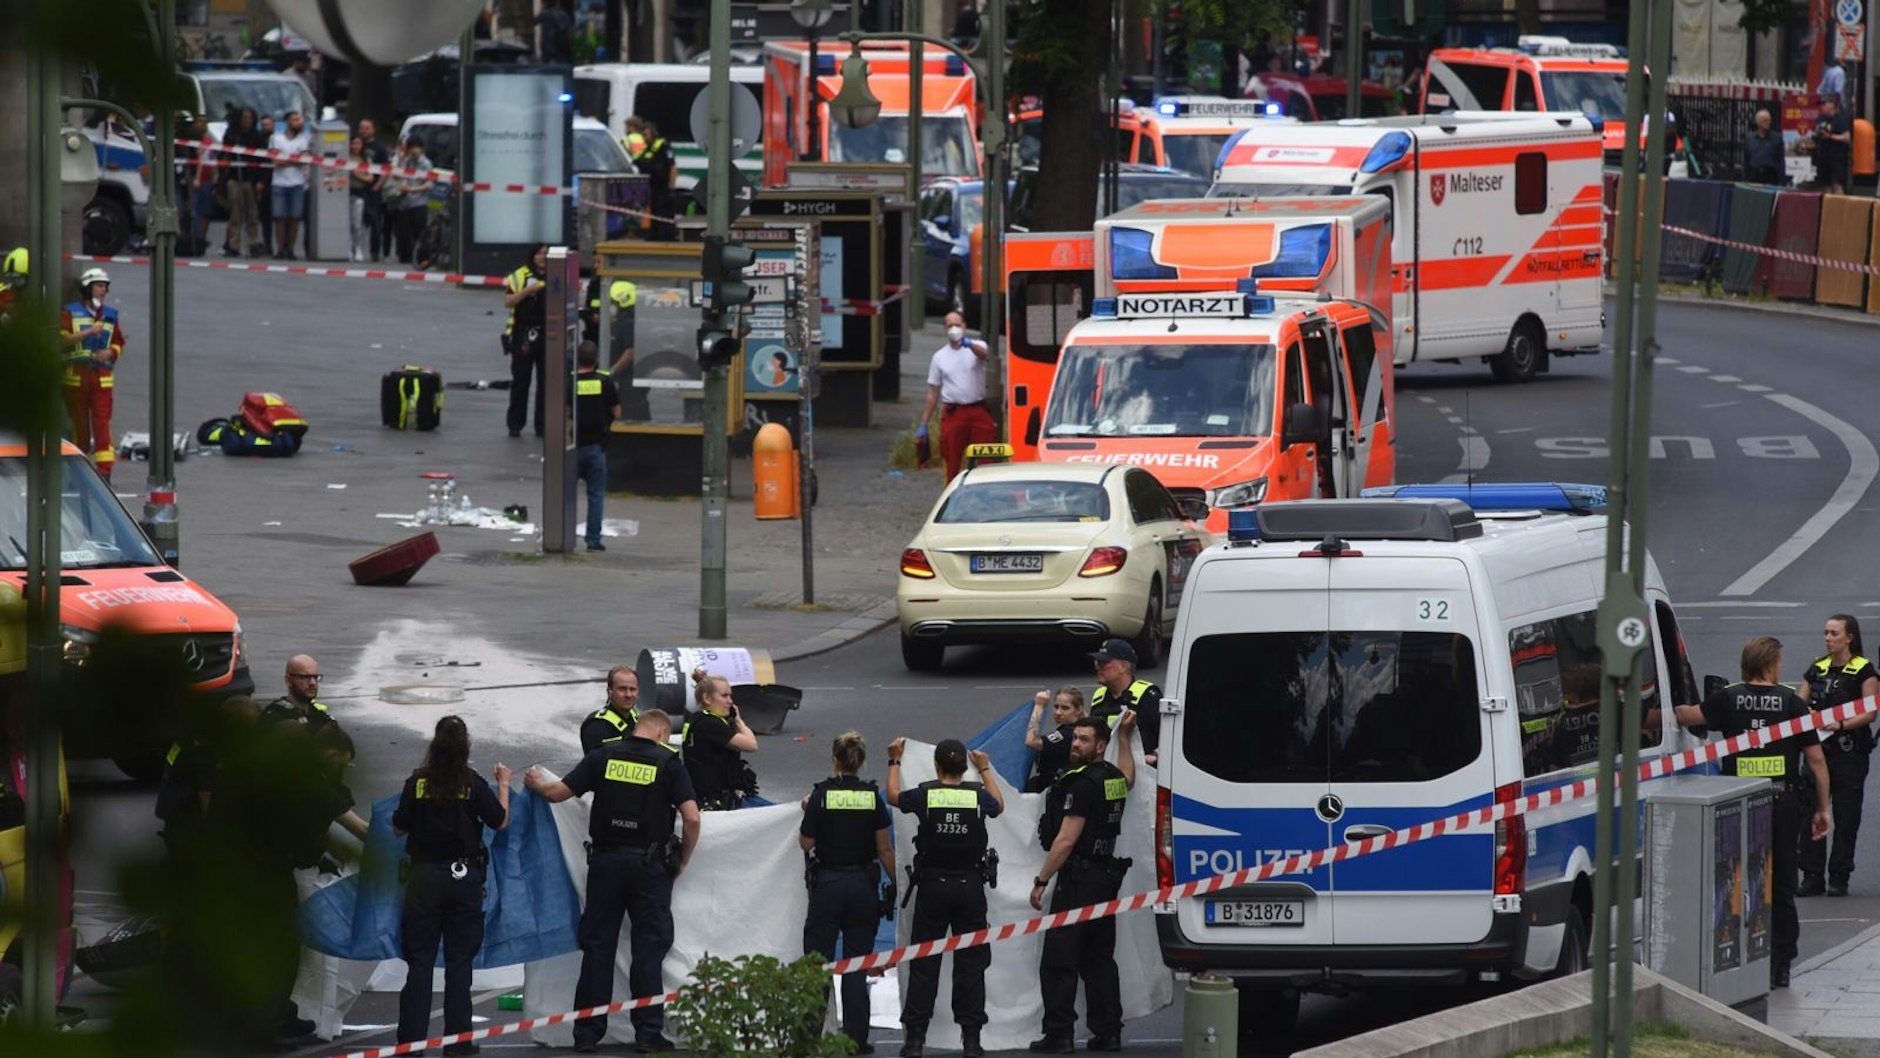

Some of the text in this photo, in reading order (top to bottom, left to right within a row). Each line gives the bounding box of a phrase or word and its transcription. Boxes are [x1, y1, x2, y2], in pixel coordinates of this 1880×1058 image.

[1189, 103, 1252, 114] FEUERWEHR
[1450, 173, 1504, 193] Malteser
[797, 202, 836, 214] HYGH
[1463, 236, 1484, 255] 112
[1526, 258, 1597, 274] NOTFALLRETTUNG
[1122, 298, 1239, 314] NOTARZT
[973, 446, 1004, 456] TAXI
[977, 555, 1041, 569] B ME 4432
[76, 587, 213, 610] FEUERWEHR
[1419, 600, 1448, 620] 32
[1736, 694, 1783, 711] POLIZEI
[1751, 718, 1766, 729] BE
[608, 762, 655, 782] POLIZEI
[1738, 759, 1783, 774] POLIZEI
[827, 791, 874, 808] POLIZEI
[929, 790, 976, 807] POLIZEI
[945, 812, 960, 823] BE
[936, 824, 968, 834] 32326
[1223, 904, 1294, 920] B 31876
